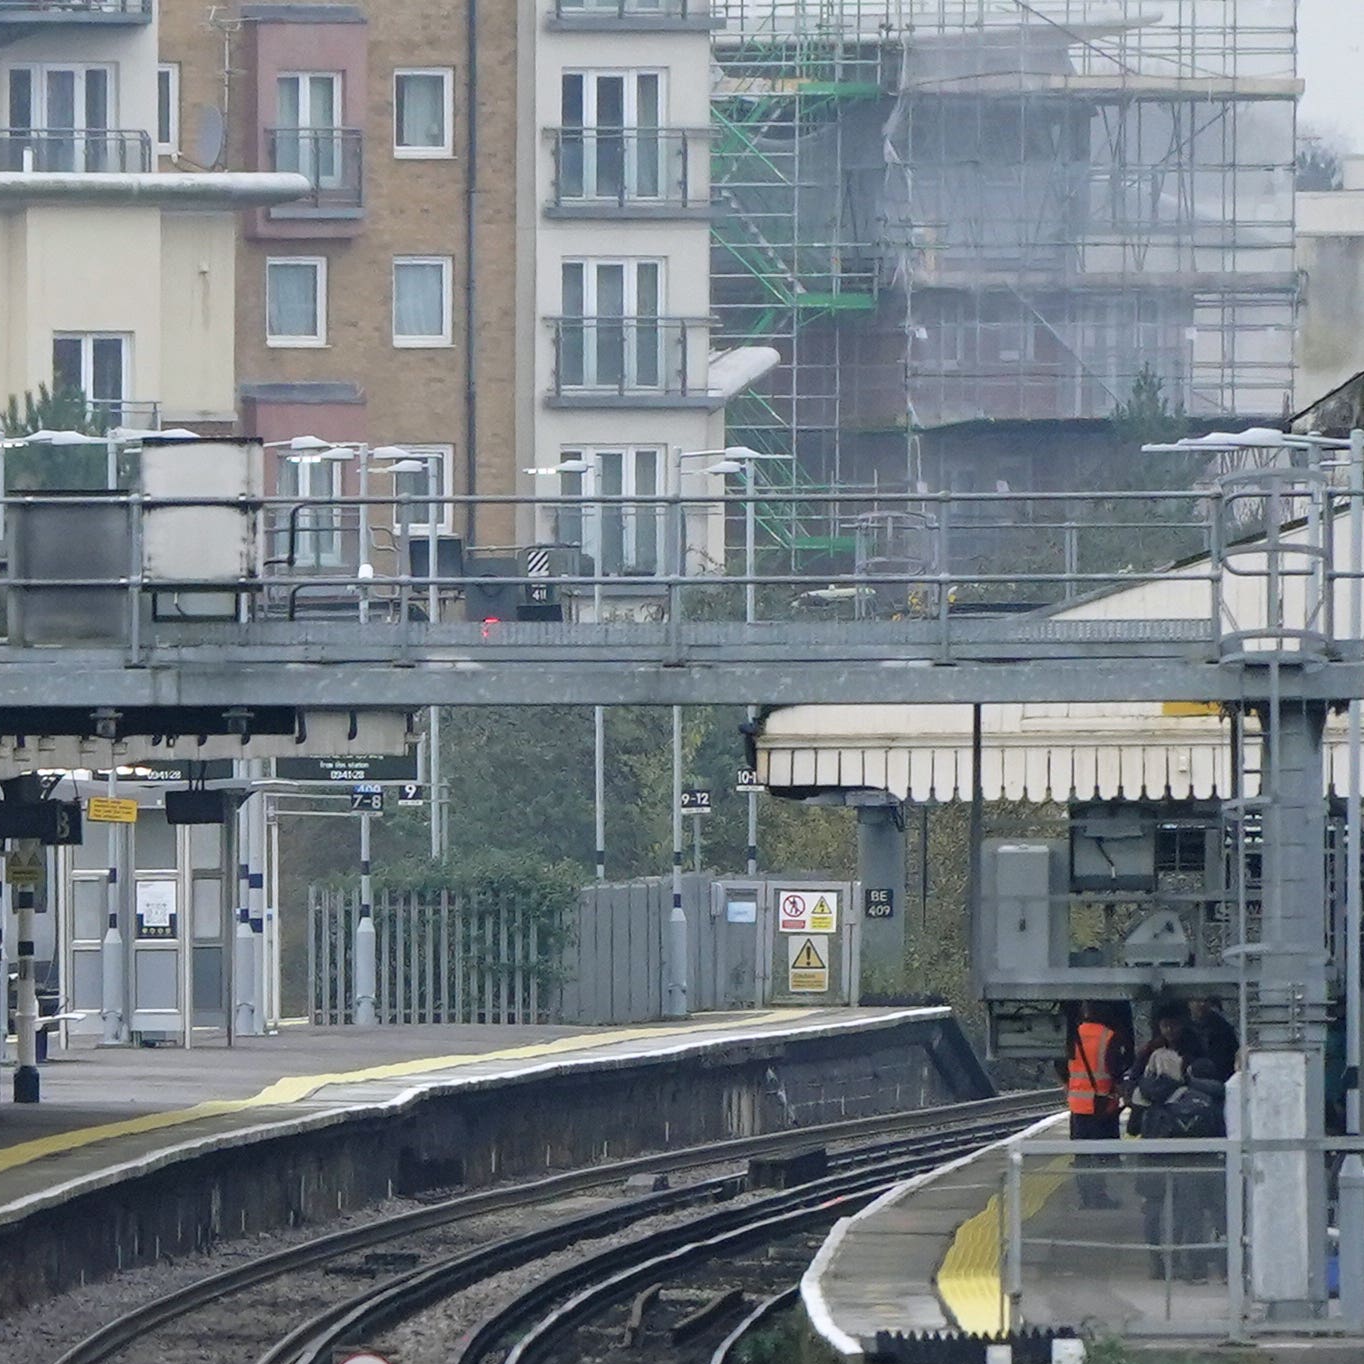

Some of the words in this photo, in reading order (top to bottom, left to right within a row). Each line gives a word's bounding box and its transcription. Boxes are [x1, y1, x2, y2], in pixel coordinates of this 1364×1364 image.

[737, 770, 757, 784] 10-1
[404, 784, 417, 799] 9
[352, 795, 382, 809] 7-8
[681, 792, 709, 805] 9-12
[871, 891, 888, 901] BE
[868, 905, 891, 916] 409
